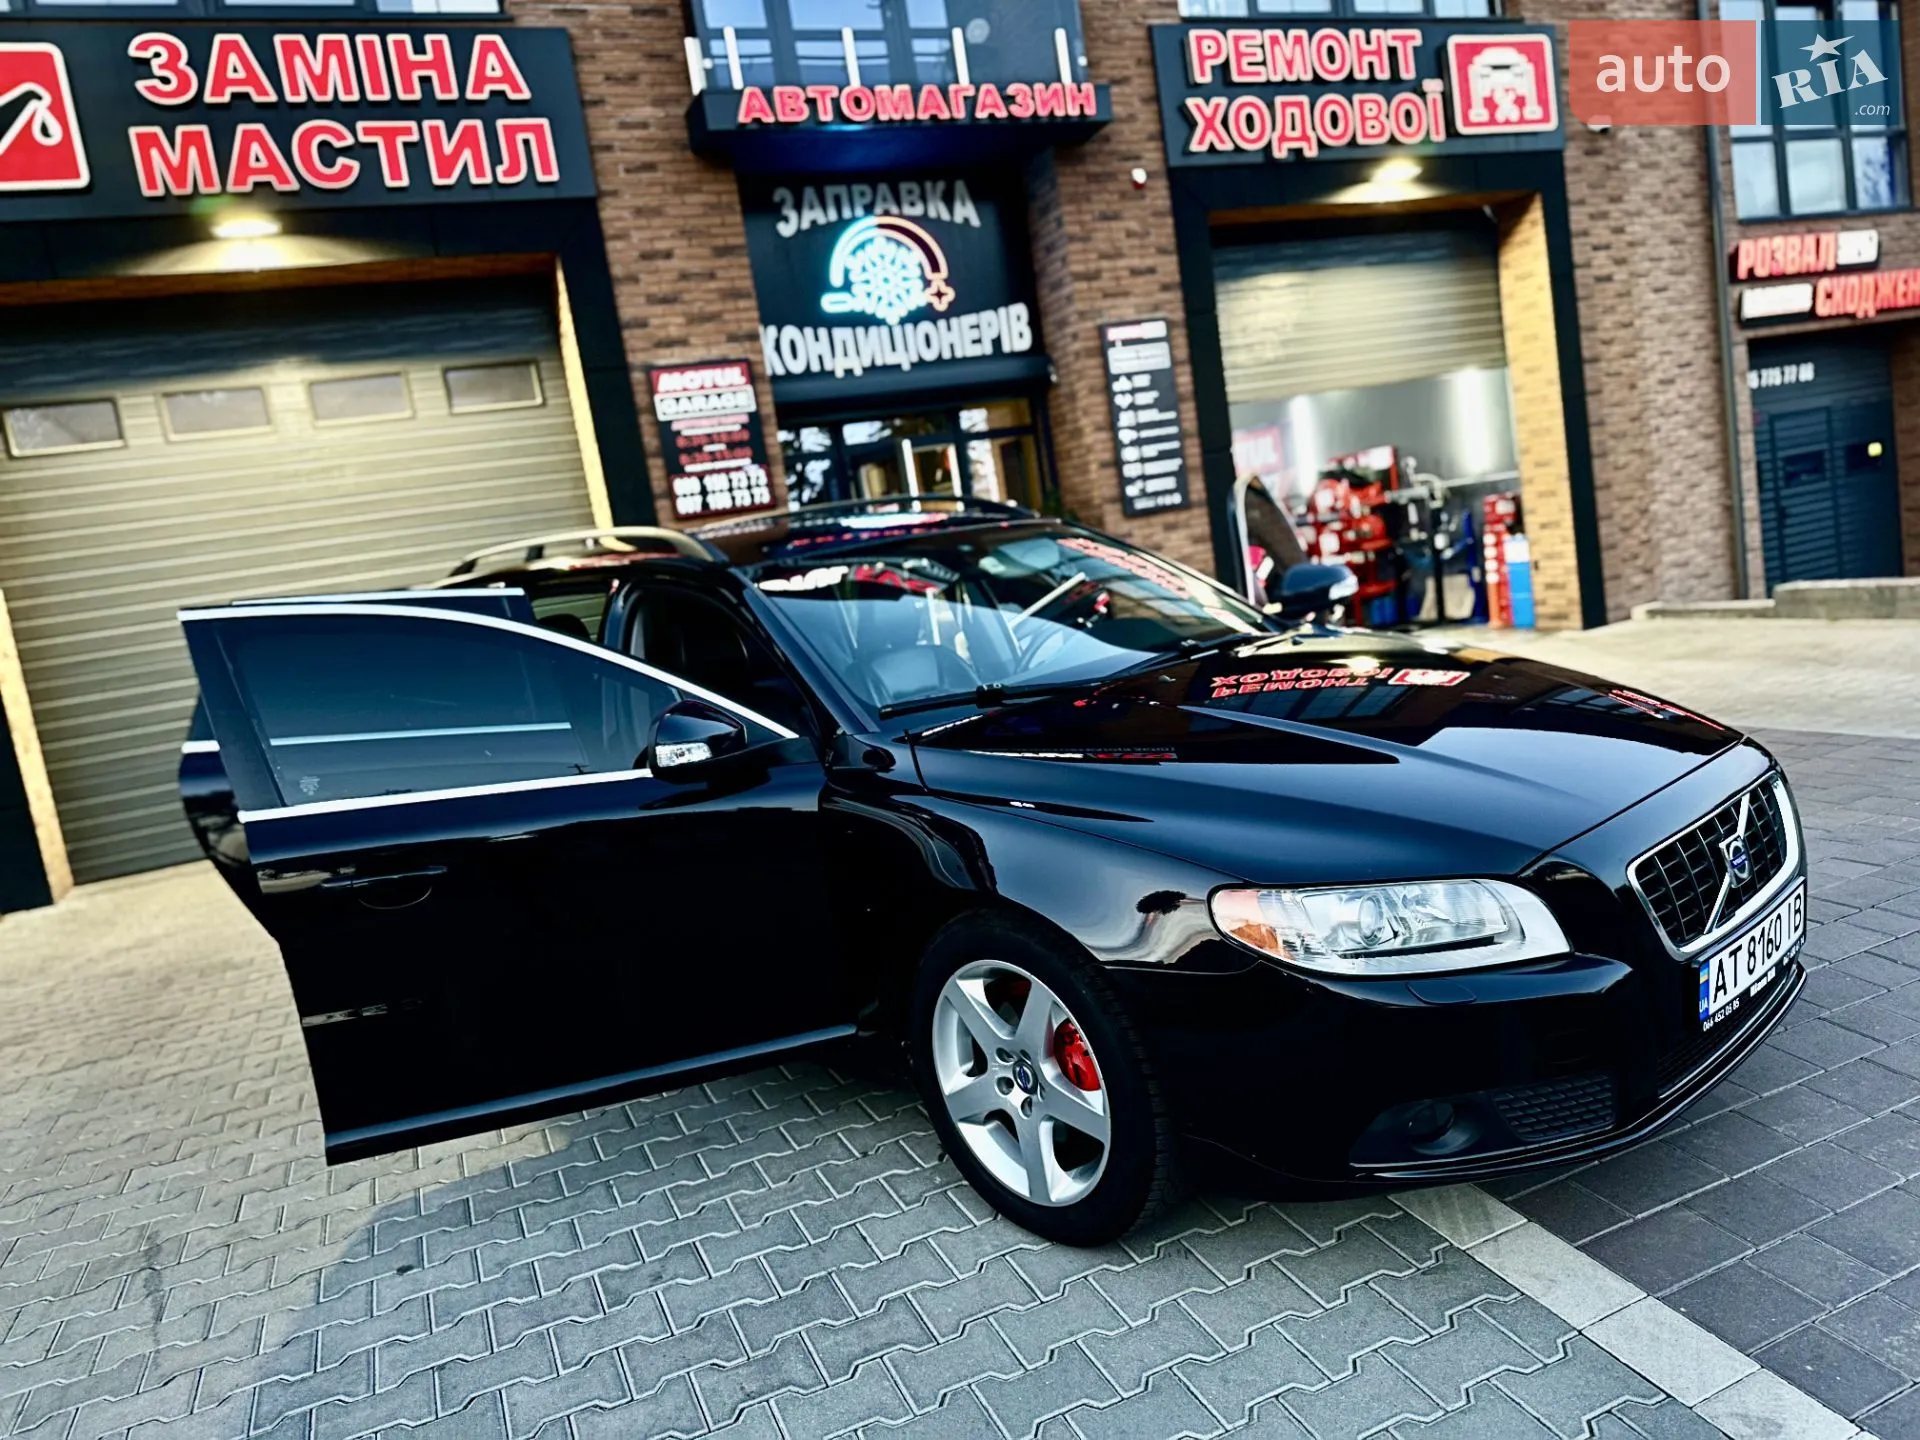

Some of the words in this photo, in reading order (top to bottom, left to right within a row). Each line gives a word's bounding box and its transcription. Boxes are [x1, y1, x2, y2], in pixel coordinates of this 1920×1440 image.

[127, 32, 532, 105] ЗАМІНА
[1188, 28, 1423, 84] РЕМОНТ
[737, 82, 1098, 124] АВТОМАГАЗИН
[1184, 78, 1446, 159] ХОДОВОЇ
[127, 118, 560, 197] МАСТИЛ
[773, 179, 981, 238] ЗАПРАВКА
[1737, 232, 1837, 280] РОЗВАЛ
[759, 302, 1033, 379] КОНДИЦІОНЕРІВ
[1713, 943, 1742, 1004] AT
[1747, 912, 1782, 976] 8160
[1788, 892, 1801, 941] IB
[1699, 997, 1708, 1013] UA
